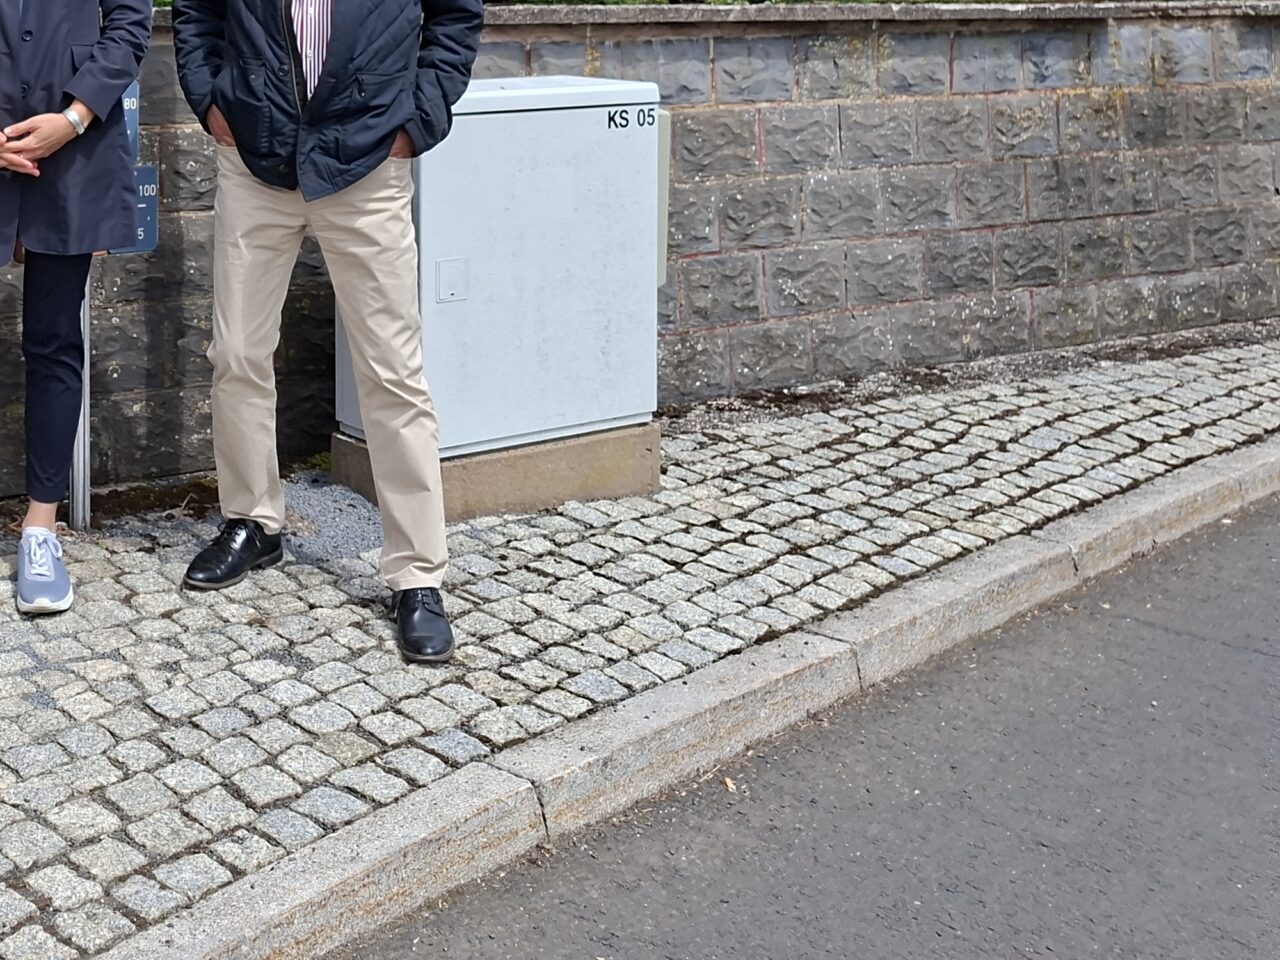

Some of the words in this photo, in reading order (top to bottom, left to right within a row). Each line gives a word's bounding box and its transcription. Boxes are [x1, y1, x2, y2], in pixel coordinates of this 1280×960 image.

[124, 97, 137, 110] 80
[607, 109, 629, 129] KS
[637, 108, 655, 127] 05
[138, 184, 157, 197] 100
